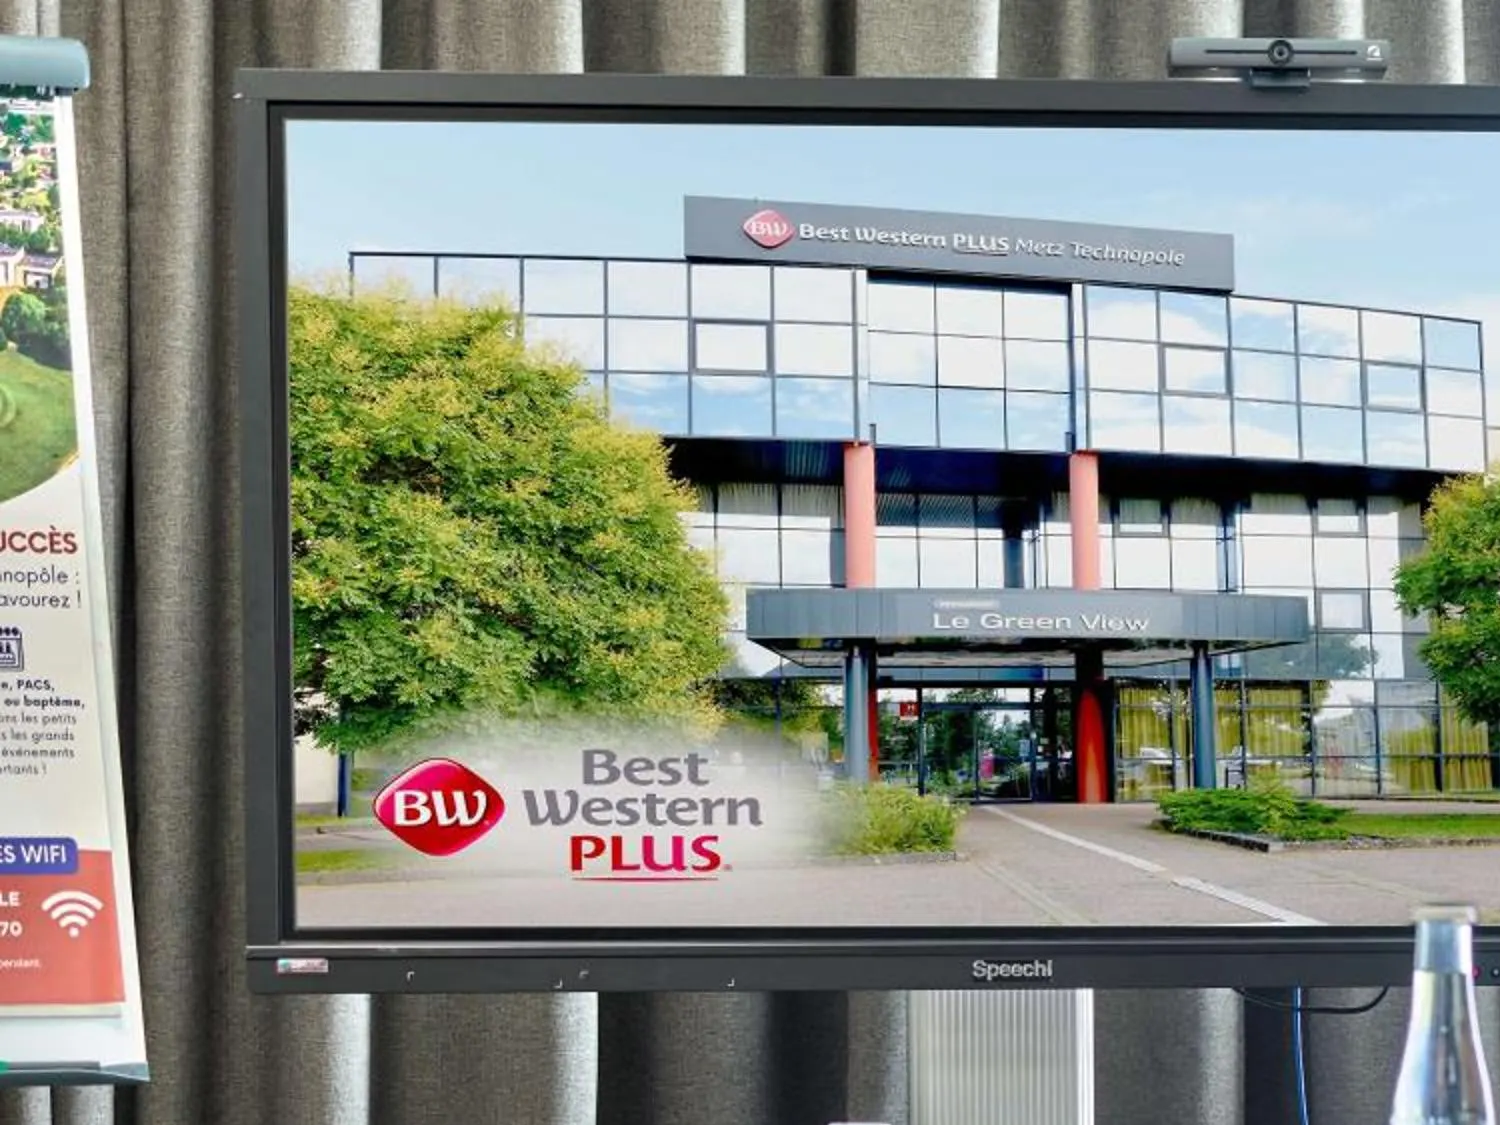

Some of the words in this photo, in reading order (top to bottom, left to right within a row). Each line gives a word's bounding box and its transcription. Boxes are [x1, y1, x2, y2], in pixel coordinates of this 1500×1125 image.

[799, 223, 850, 242] Best
[854, 227, 947, 247] Western
[953, 232, 1010, 252] PLUS
[1015, 238, 1064, 256] Metz
[1070, 241, 1185, 266] Technopole
[933, 613, 969, 629] Le
[980, 613, 1071, 630] Green
[1079, 614, 1150, 632] View
[16, 679, 55, 692] PACS,
[42, 714, 77, 726] petits
[31, 727, 74, 745] grands
[582, 749, 710, 786] Best
[394, 789, 490, 827] BW
[523, 789, 763, 826] Western
[20, 844, 68, 865] WIFI
[570, 835, 722, 872] PLUS
